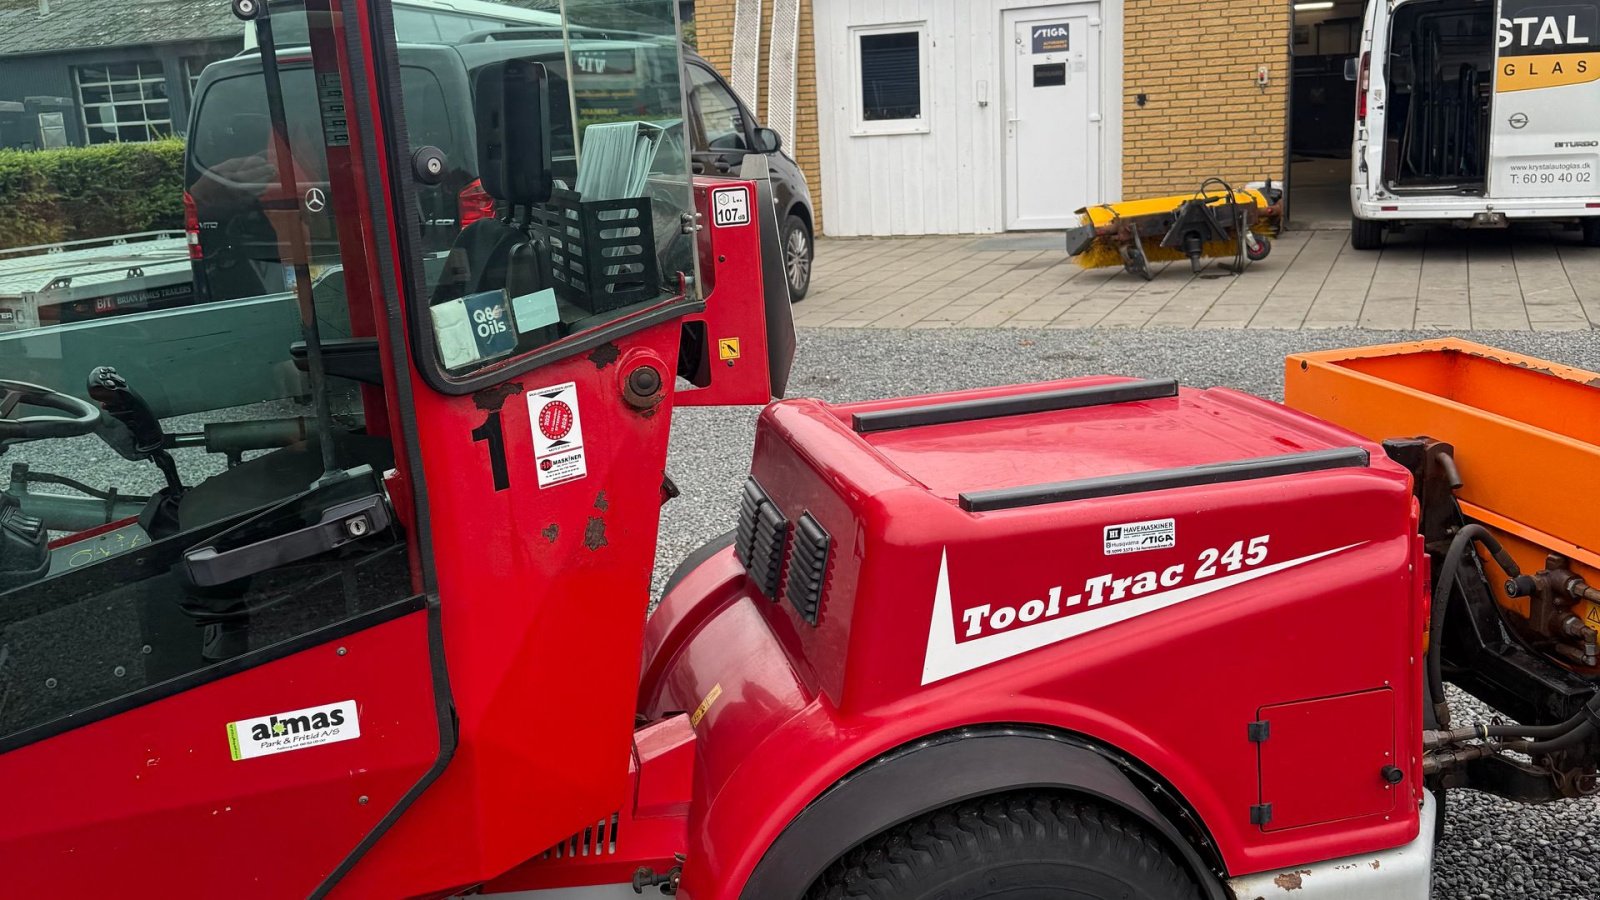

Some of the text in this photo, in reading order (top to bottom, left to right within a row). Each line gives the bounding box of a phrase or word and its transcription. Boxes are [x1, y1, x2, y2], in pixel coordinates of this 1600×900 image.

[1034, 28, 1067, 38] STIGA
[1504, 60, 1587, 76] GLAS
[1510, 172, 1591, 184] T: 60 90 40 02
[718, 208, 738, 222] 107
[117, 296, 138, 304] BRIAN
[161, 286, 192, 297] TRAILERS
[473, 307, 494, 323] Q8
[477, 320, 507, 338] Oils
[471, 412, 511, 492] 1
[1123, 521, 1173, 533] HAVEMASKINER
[1142, 535, 1173, 545] STIGA
[1194, 534, 1270, 580] 245
[962, 563, 1184, 637] Tool-Trac
[260, 740, 282, 748] Park
[293, 732, 320, 743] Fritid
[321, 728, 340, 738] A/S
